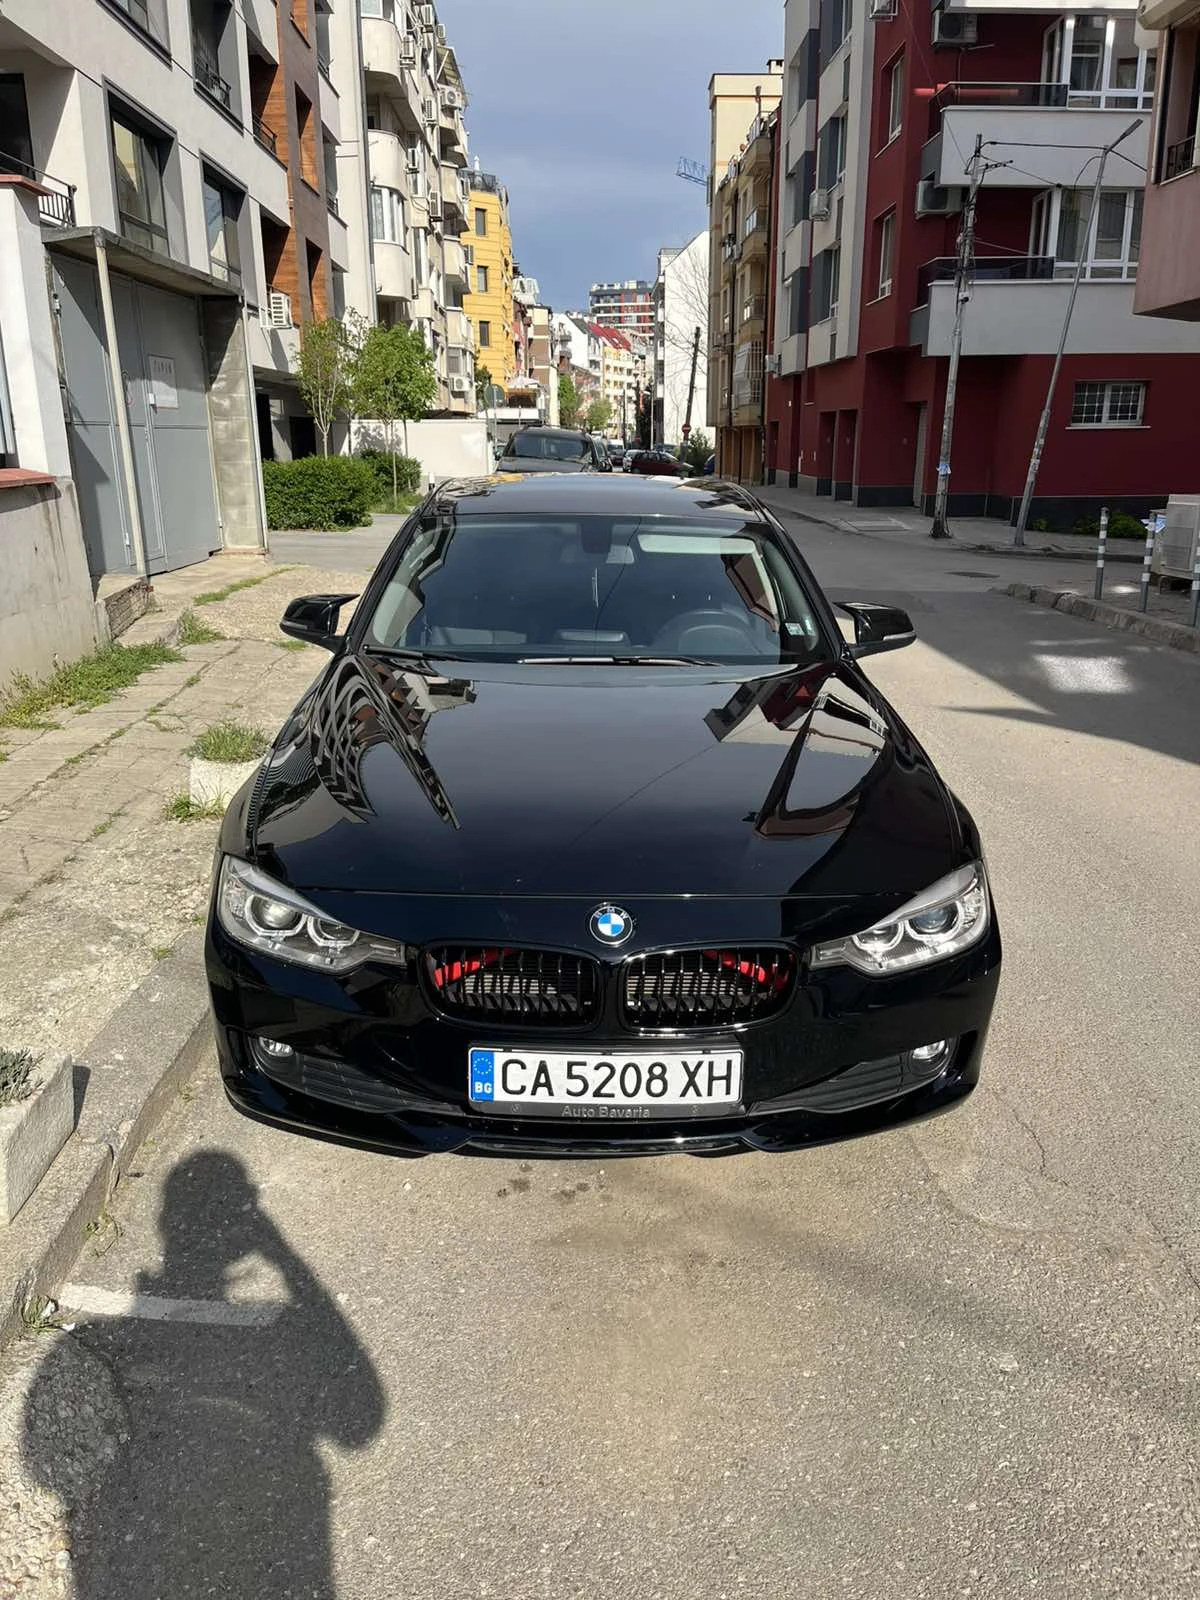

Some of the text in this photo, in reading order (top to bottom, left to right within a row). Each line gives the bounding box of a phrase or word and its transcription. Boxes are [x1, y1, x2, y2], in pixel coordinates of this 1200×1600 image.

[593, 907, 630, 919] BMW
[501, 1058, 733, 1098] CA 5208 XH
[475, 1083, 493, 1094] BG
[561, 1105, 650, 1119] Auto Bavaria
